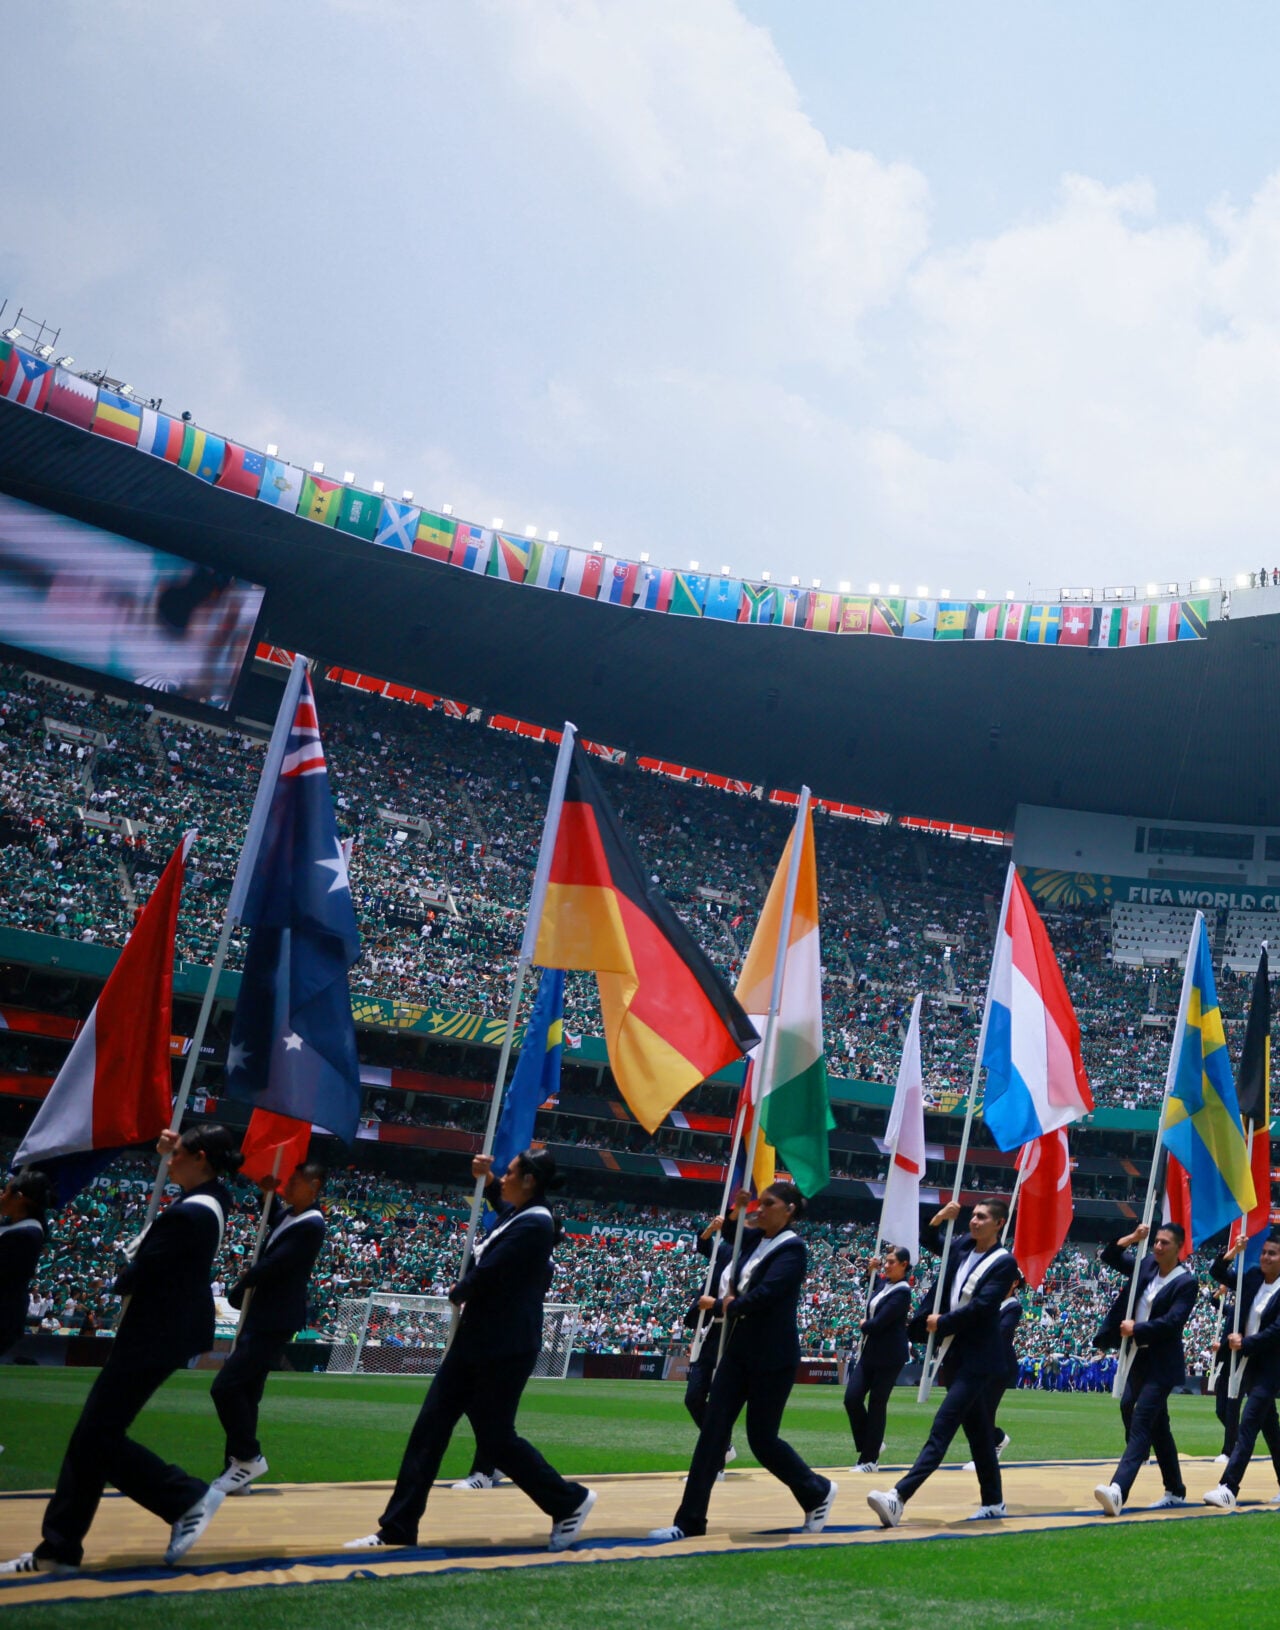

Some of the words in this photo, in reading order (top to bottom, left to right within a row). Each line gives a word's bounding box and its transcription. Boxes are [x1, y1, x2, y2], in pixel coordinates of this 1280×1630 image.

[1128, 886, 1173, 904] FIFA
[1178, 890, 1256, 910] WORLD
[592, 1226, 674, 1243] MEXICO
